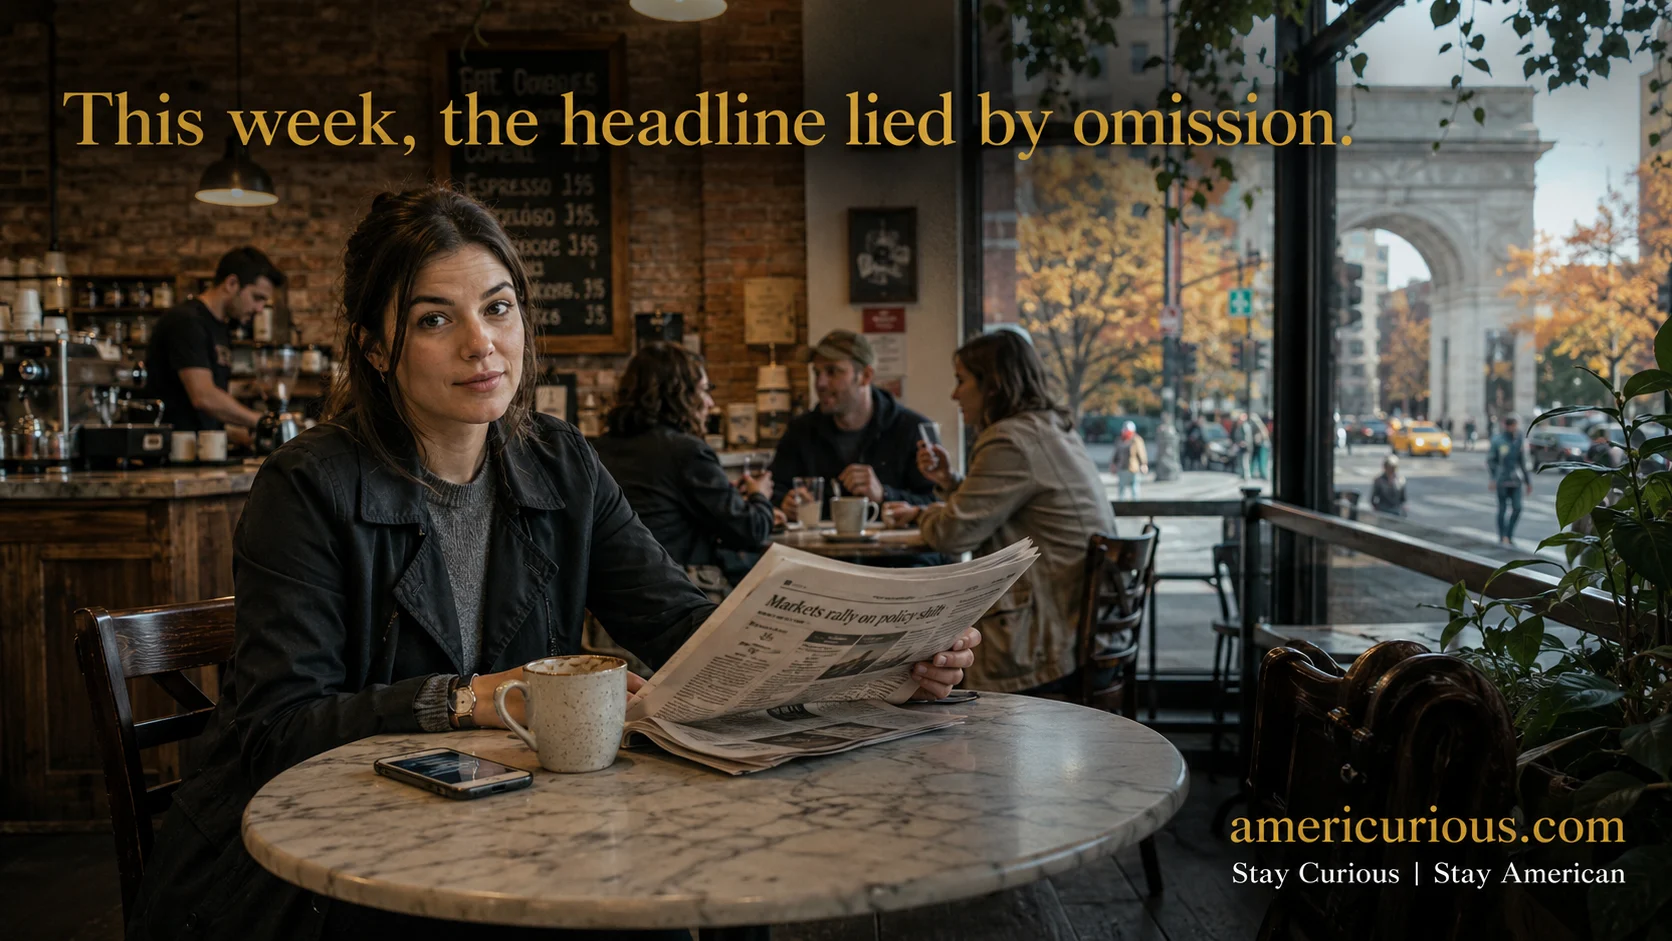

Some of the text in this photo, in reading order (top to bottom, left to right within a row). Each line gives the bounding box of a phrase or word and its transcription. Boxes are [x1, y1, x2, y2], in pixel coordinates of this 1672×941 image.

[765, 594, 825, 618] Markets
[824, 608, 859, 626] rally
[858, 614, 875, 624] on
[873, 610, 918, 627] policy
